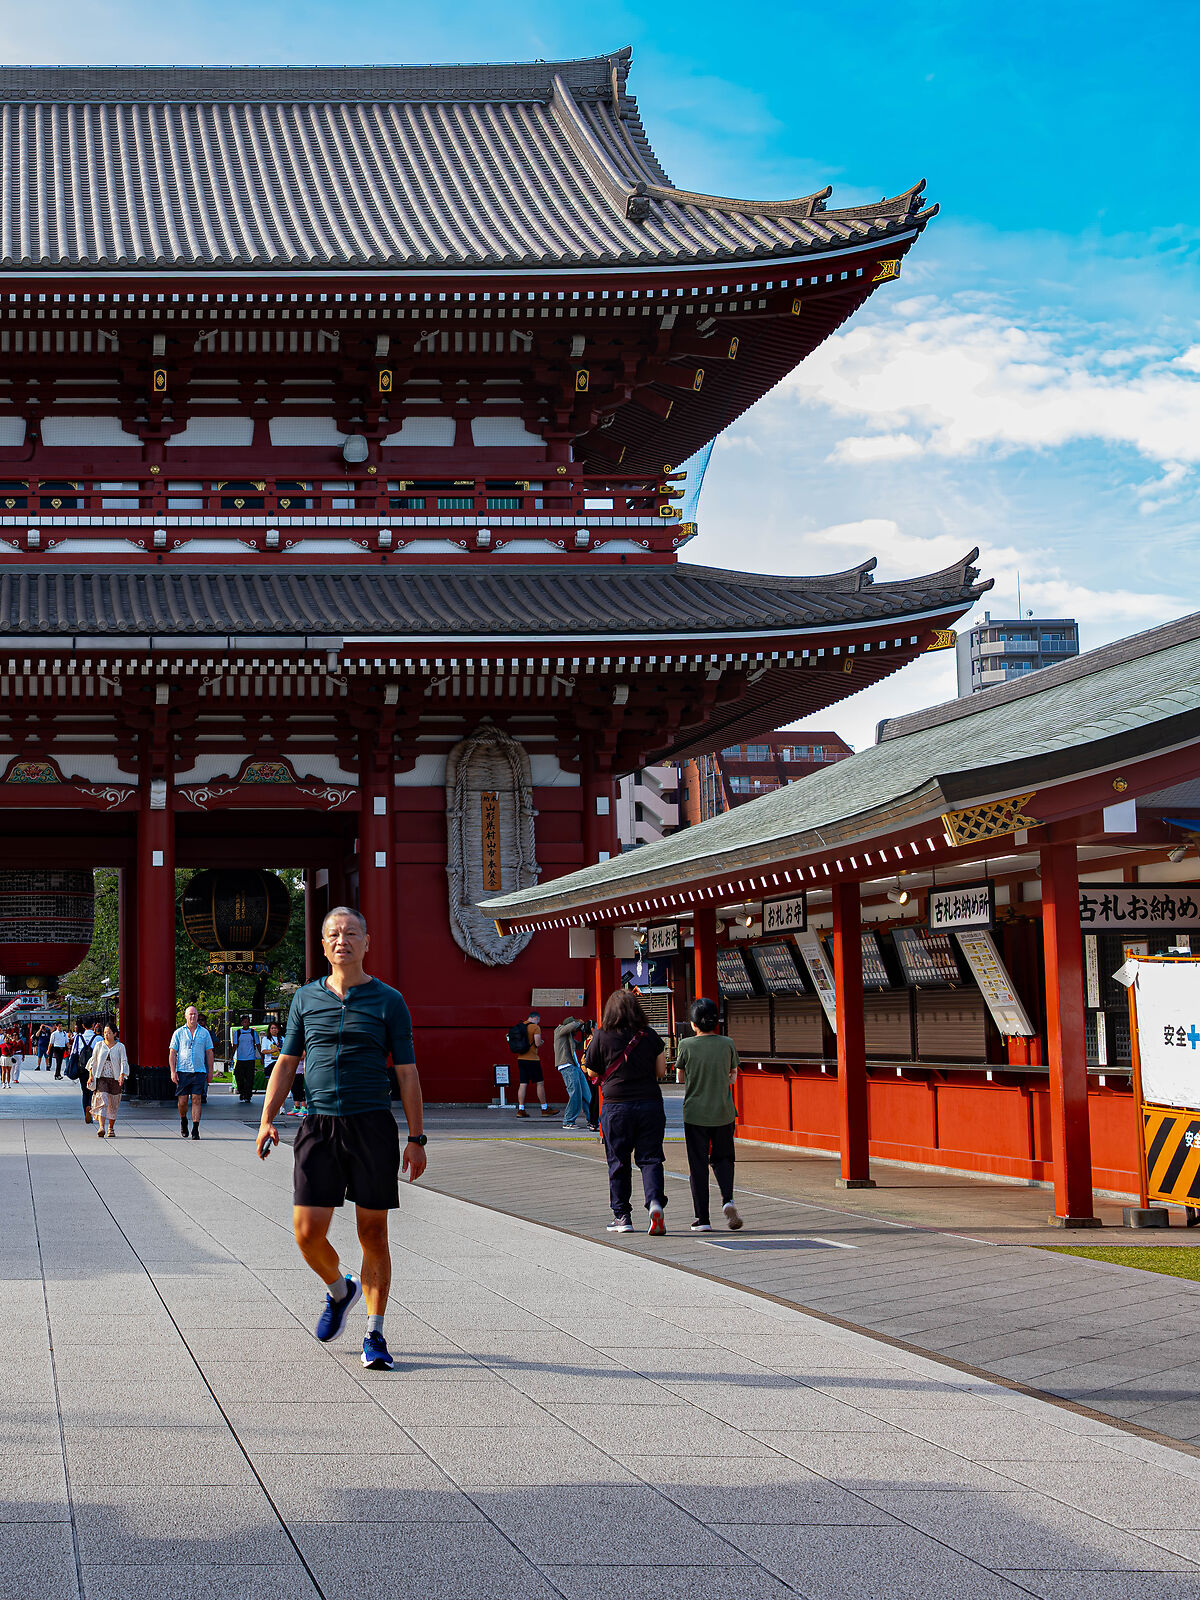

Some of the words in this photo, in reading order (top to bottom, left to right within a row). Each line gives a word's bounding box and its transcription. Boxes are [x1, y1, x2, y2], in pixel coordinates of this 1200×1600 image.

[768, 901, 802, 928] お札お守
[935, 892, 990, 922] 古札お納め所
[1079, 894, 1200, 922] 古札お納め
[1163, 1024, 1187, 1047] 安全
